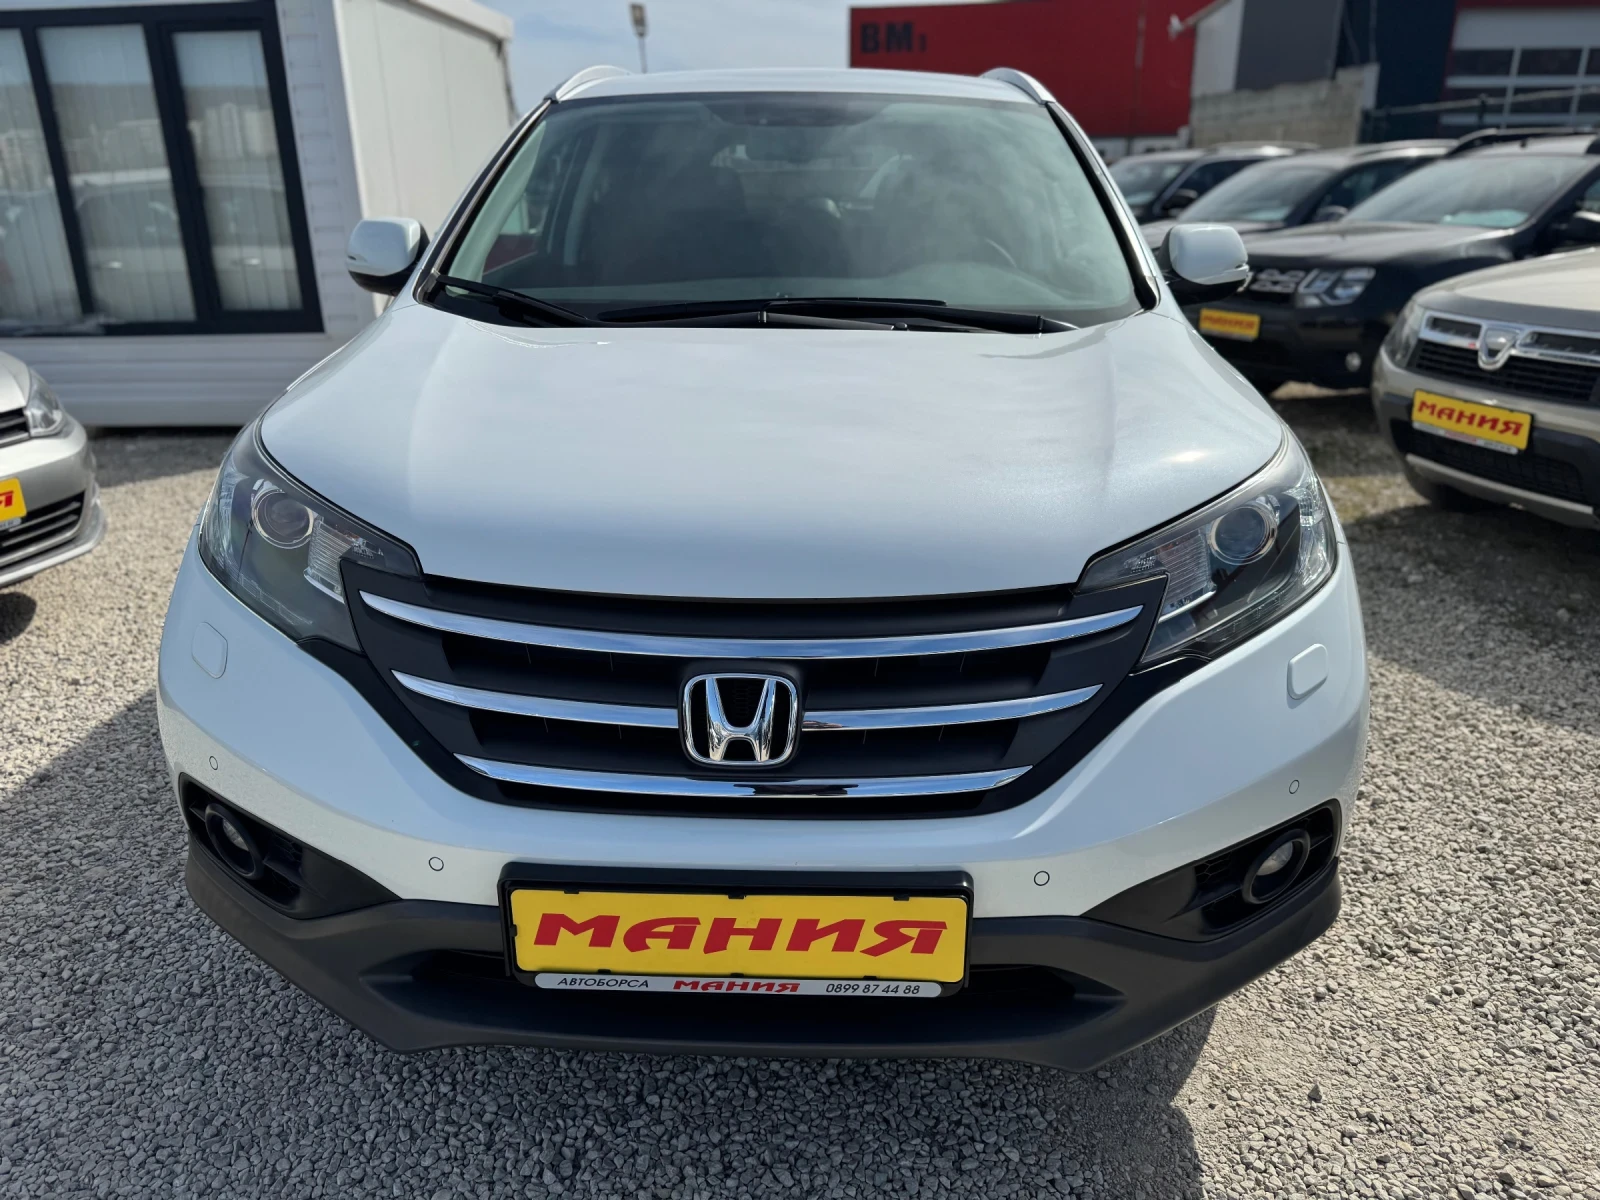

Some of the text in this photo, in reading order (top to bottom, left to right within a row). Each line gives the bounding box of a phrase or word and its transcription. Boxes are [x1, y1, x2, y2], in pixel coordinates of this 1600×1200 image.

[1417, 400, 1523, 436] МАНИЯ
[533, 913, 948, 957] МАНИЯ
[557, 977, 921, 995] АВТОБОРСА МАНИЯ 0899 87 44 88
